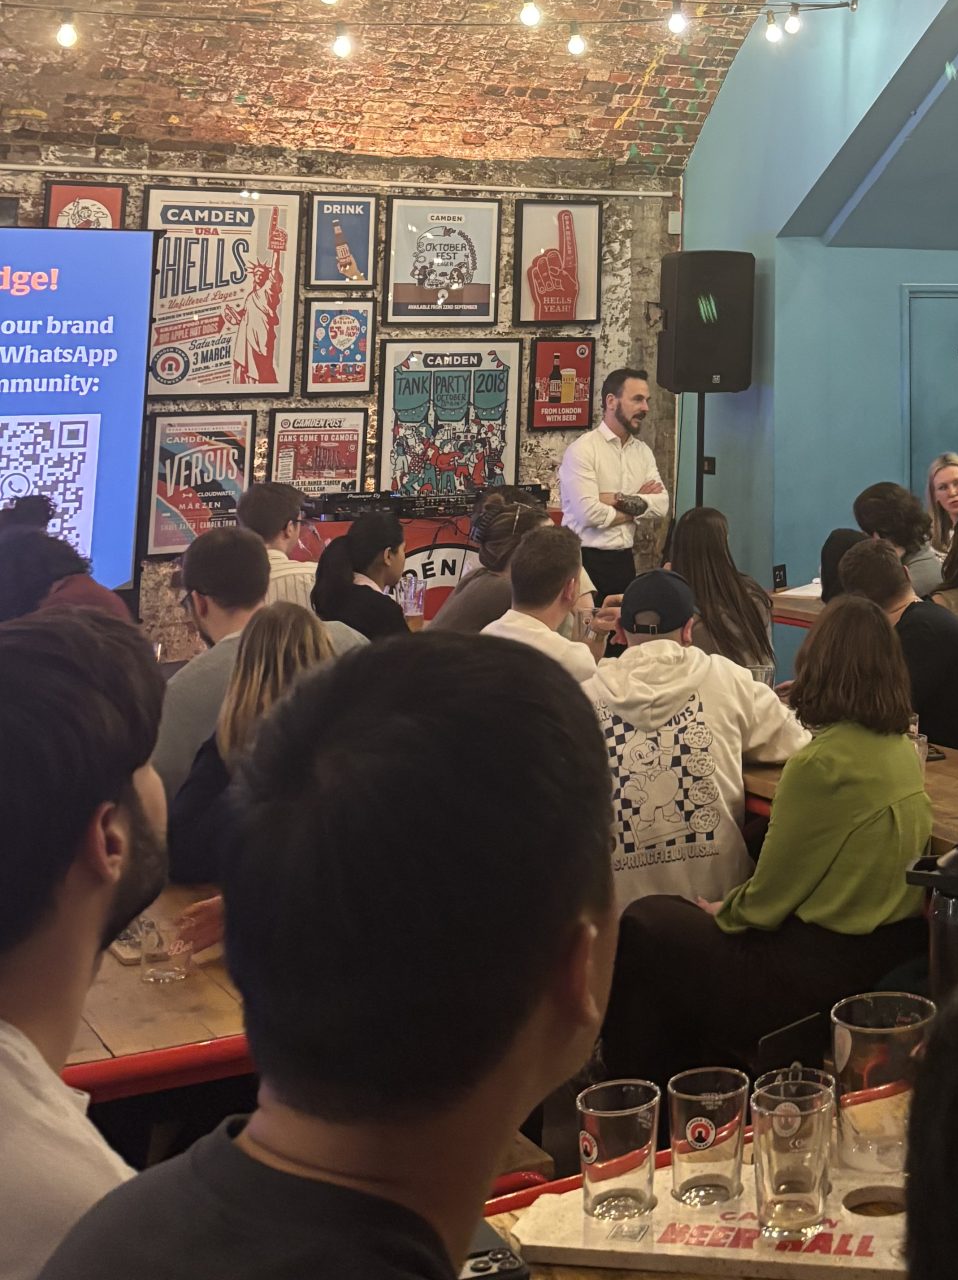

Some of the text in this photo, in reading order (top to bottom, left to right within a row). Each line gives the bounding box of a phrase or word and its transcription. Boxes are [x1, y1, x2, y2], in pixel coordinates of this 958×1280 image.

[167, 209, 250, 223] CAMDEN
[323, 204, 364, 214] DRINK
[195, 227, 220, 236] USA
[436, 252, 458, 260] FEST
[159, 236, 250, 299] HELLS
[168, 290, 237, 309] Unfiltered Lager
[544, 305, 571, 313] YEAH!
[1, 316, 114, 334] our brand
[189, 335, 232, 351] Saturday
[1, 344, 118, 367] WhatsApp
[193, 345, 231, 365] 3 MARCH
[427, 356, 478, 365] CAMDEN
[397, 373, 506, 395] TANK PARTY 2018
[292, 418, 346, 428] CAMDEN POST
[166, 436, 210, 444] CAMDEN
[165, 448, 239, 497] VERSUS
[197, 490, 236, 498] CLOUDWATER
[613, 848, 687, 872] SPRINGFIELD,
[656, 1222, 761, 1249] BEER
